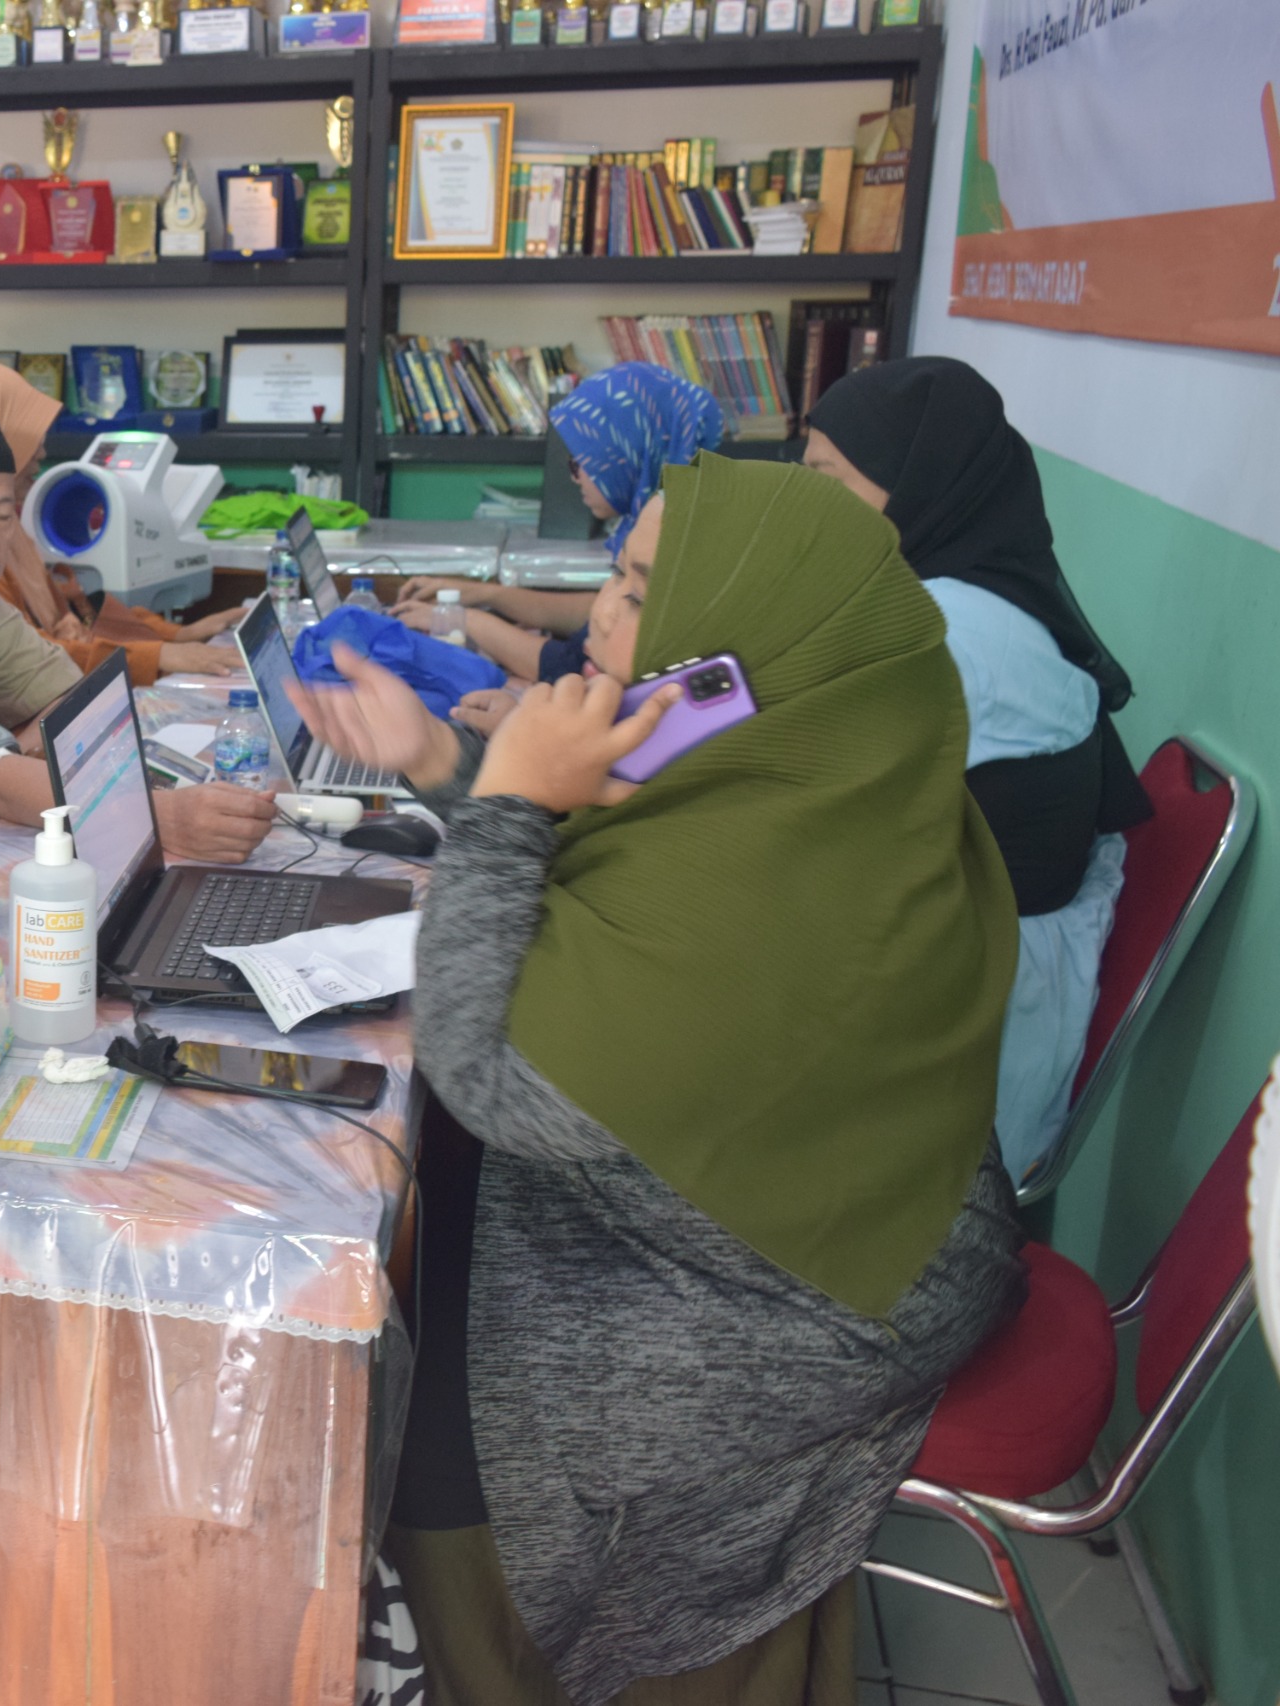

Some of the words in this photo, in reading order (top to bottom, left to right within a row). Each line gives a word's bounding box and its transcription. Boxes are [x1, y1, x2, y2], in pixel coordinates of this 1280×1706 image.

[24, 933, 55, 946] HAND
[23, 947, 81, 961] SANITIZER
[322, 980, 349, 995] 133
